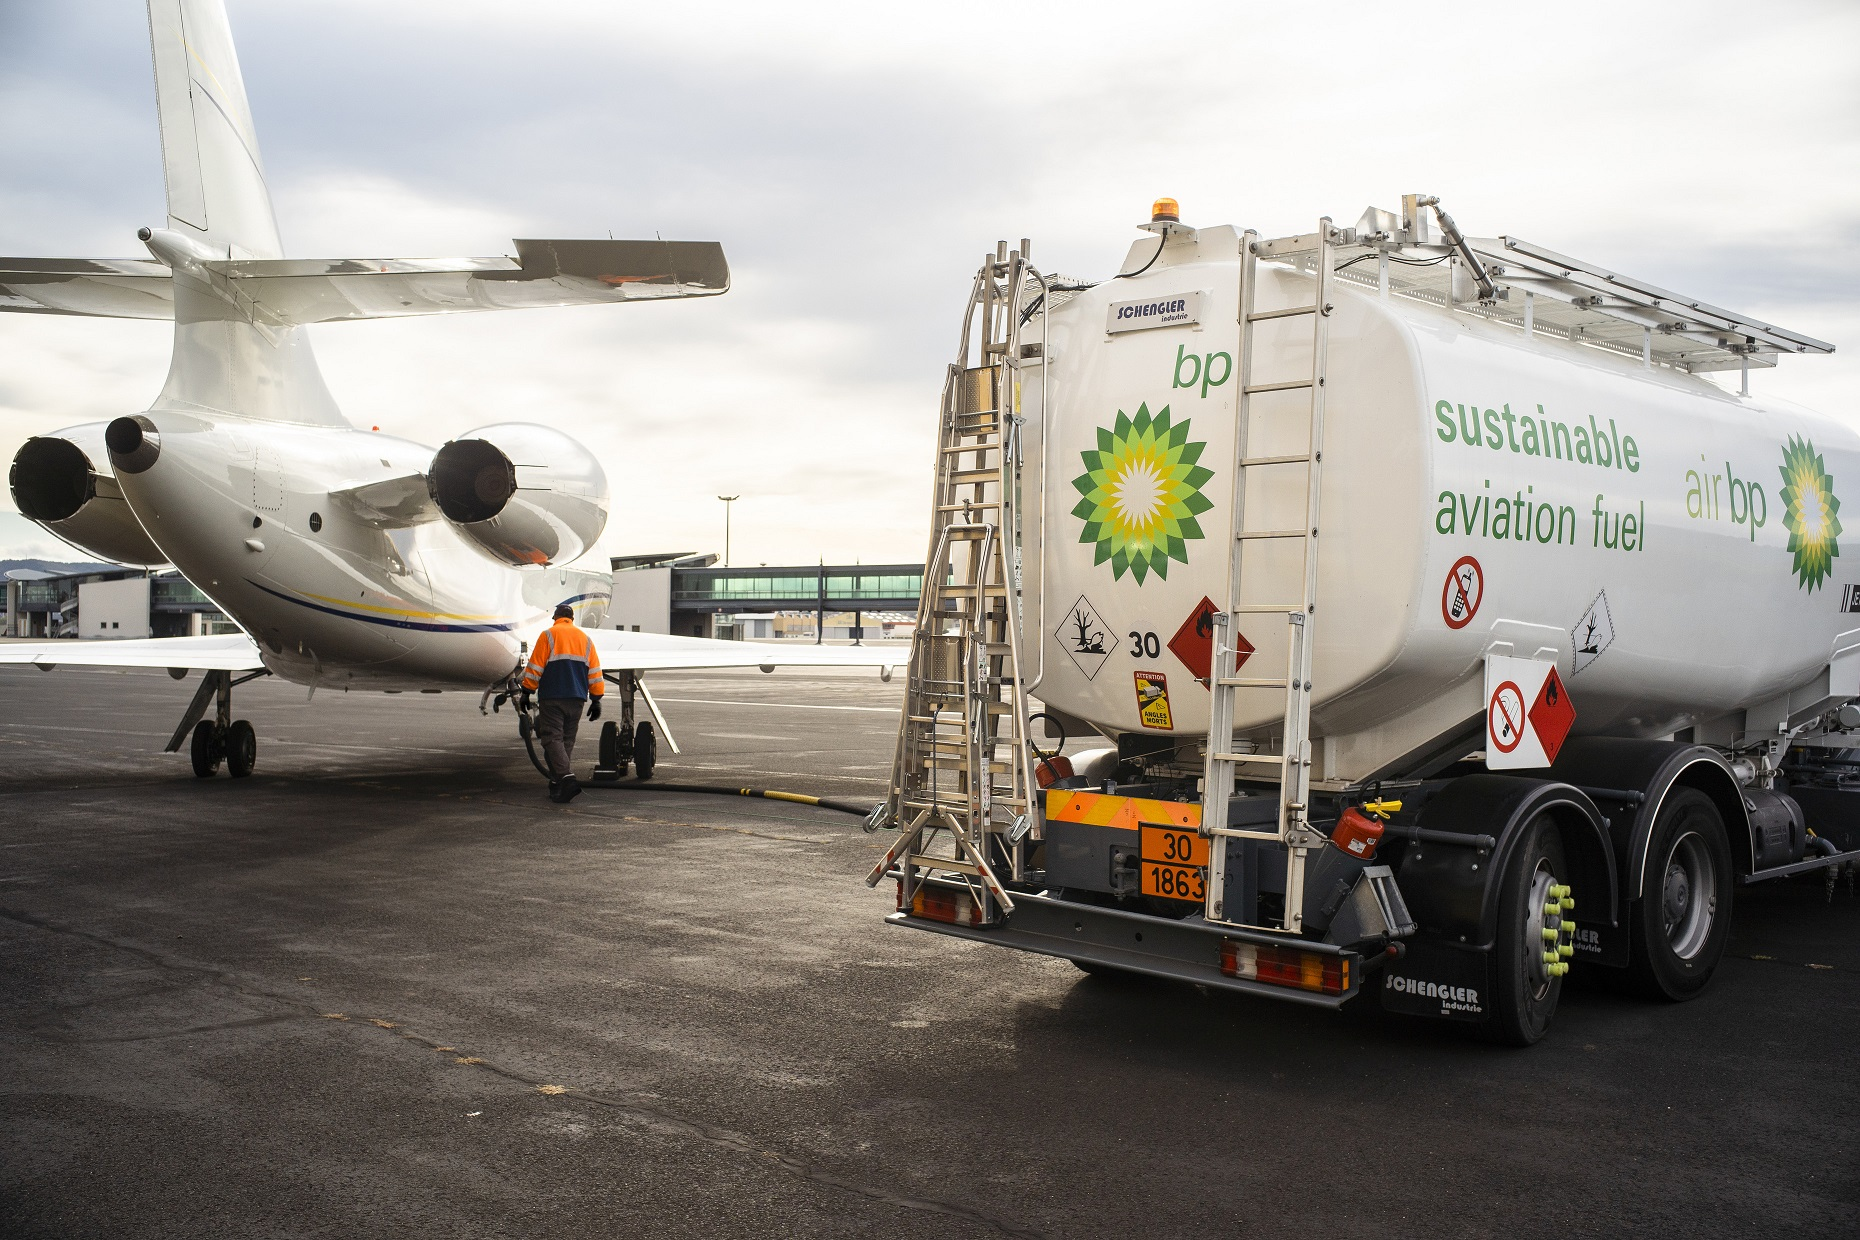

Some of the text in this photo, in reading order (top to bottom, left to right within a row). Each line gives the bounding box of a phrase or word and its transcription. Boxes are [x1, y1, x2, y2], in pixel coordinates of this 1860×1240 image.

[1117, 299, 1186, 320] SCHENGLER
[1161, 312, 1189, 323] industrie
[1172, 343, 1233, 399] bp
[1435, 399, 1640, 473] sustainable
[1435, 479, 1644, 552] aviation fuel
[1128, 630, 1161, 659] 30
[1136, 672, 1165, 681] ATTENTION
[1144, 711, 1168, 719] ANGLES
[1146, 717, 1168, 725] MORTS
[1163, 832, 1192, 862] 30
[1151, 866, 1205, 899] 1863
[1385, 974, 1479, 1004] SCHENGLER
[1442, 1000, 1483, 1013] industrie
